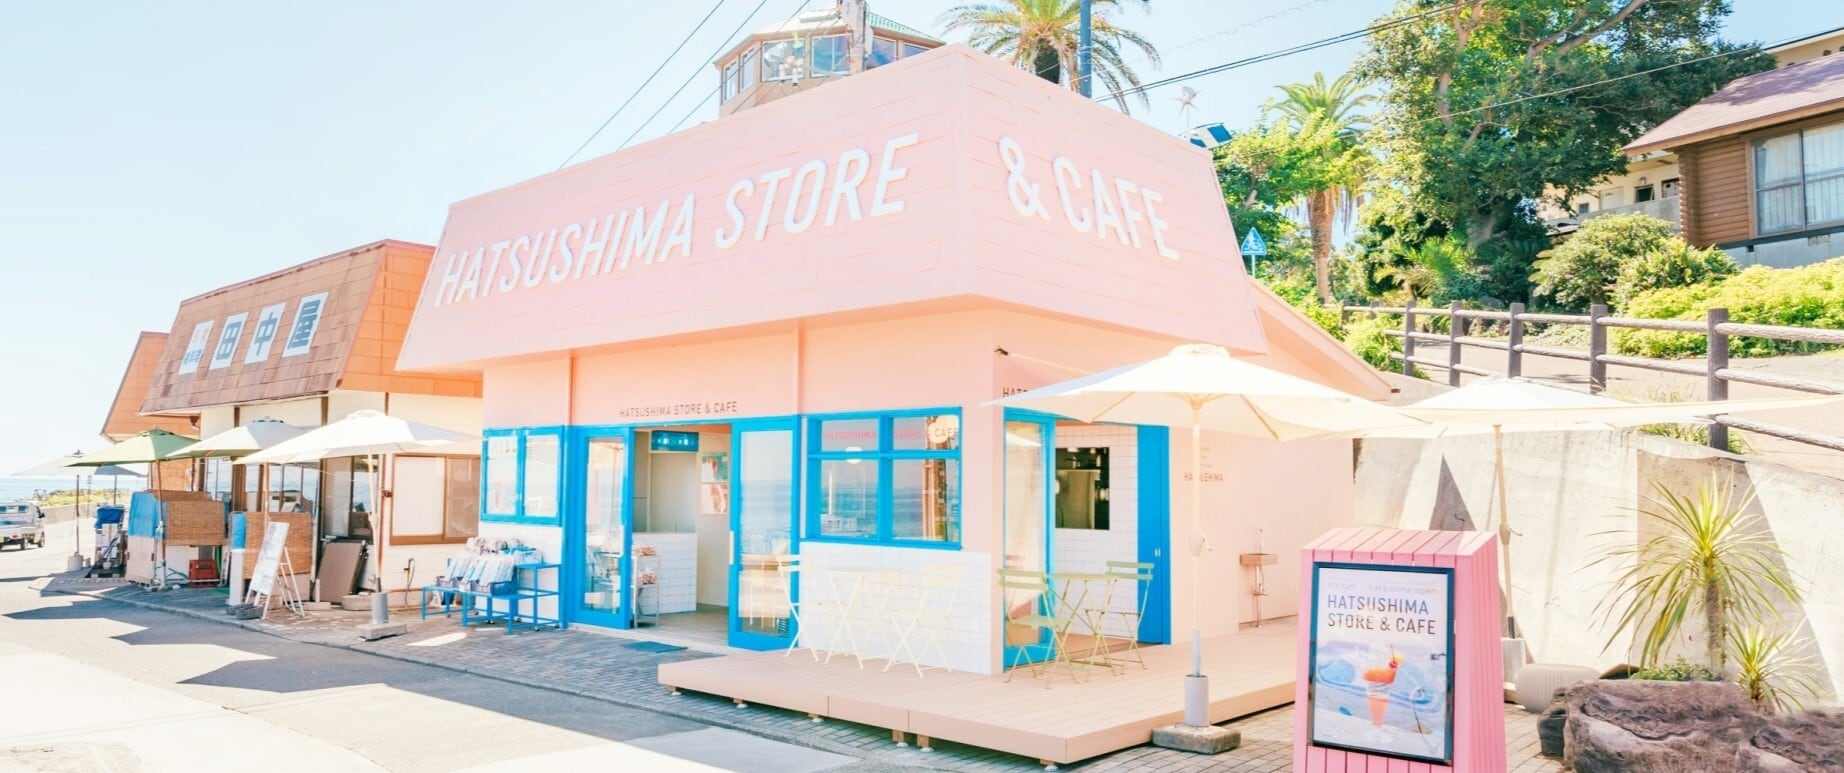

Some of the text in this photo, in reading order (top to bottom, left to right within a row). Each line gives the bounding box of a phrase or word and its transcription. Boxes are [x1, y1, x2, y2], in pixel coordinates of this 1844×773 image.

[434, 132, 1180, 307] HATSUSHIMA STORE & CAFE
[216, 299, 321, 361] 田中屋
[619, 401, 737, 418] HATSUSHIMA STORE & CAFE
[823, 430, 877, 440] HATSUSHIMA
[934, 427, 958, 438] CAFE
[1327, 594, 1429, 615] HATSUSHIMA
[1327, 612, 1436, 635] STORE & CAFE
